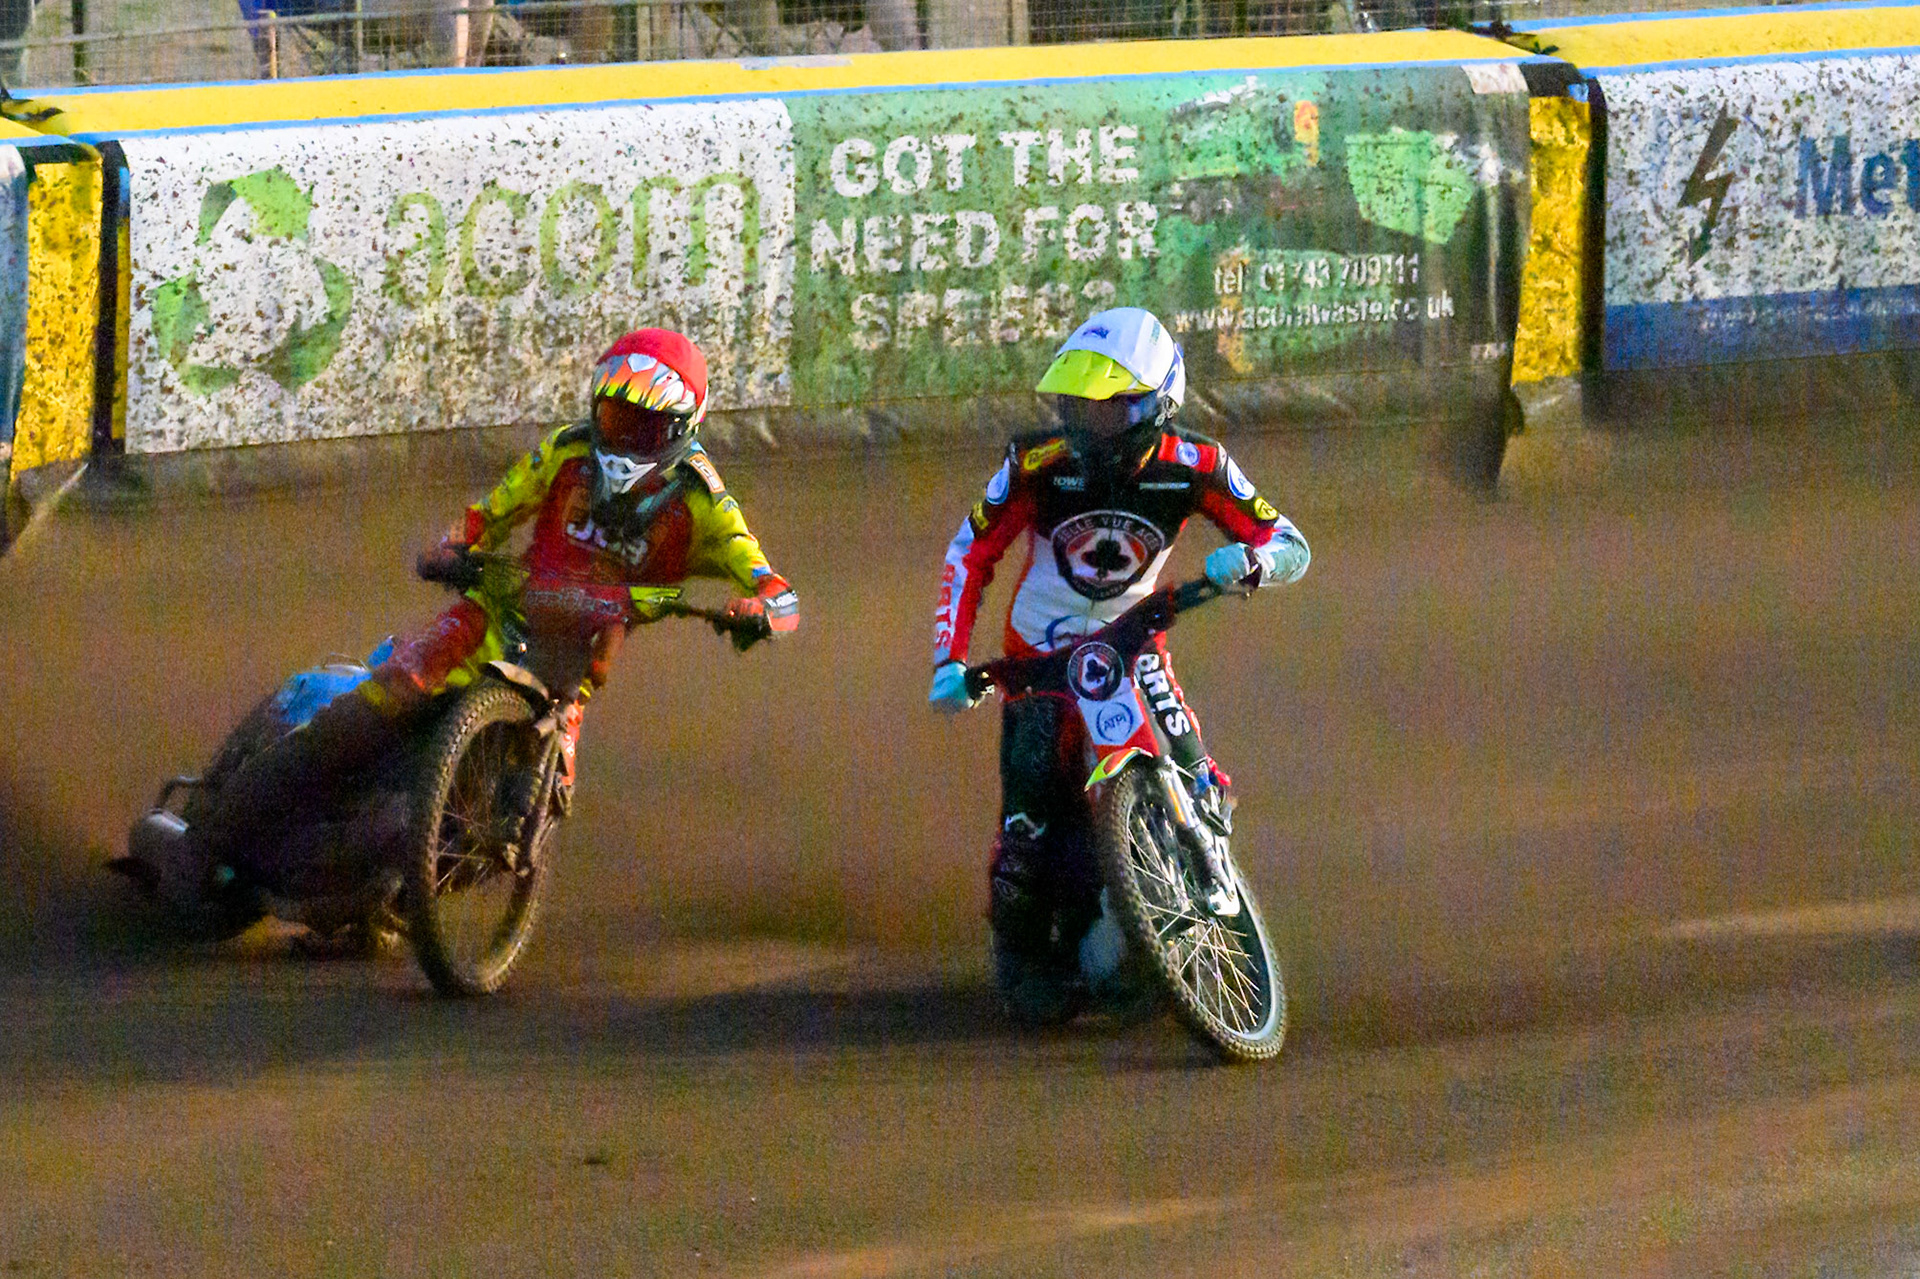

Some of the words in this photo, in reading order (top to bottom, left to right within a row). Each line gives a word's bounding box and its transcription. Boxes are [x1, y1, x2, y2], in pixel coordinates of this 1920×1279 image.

[830, 134, 977, 198] GOT
[999, 125, 1139, 188] THE
[810, 211, 1000, 275] NEED
[1022, 202, 1159, 263] FOR
